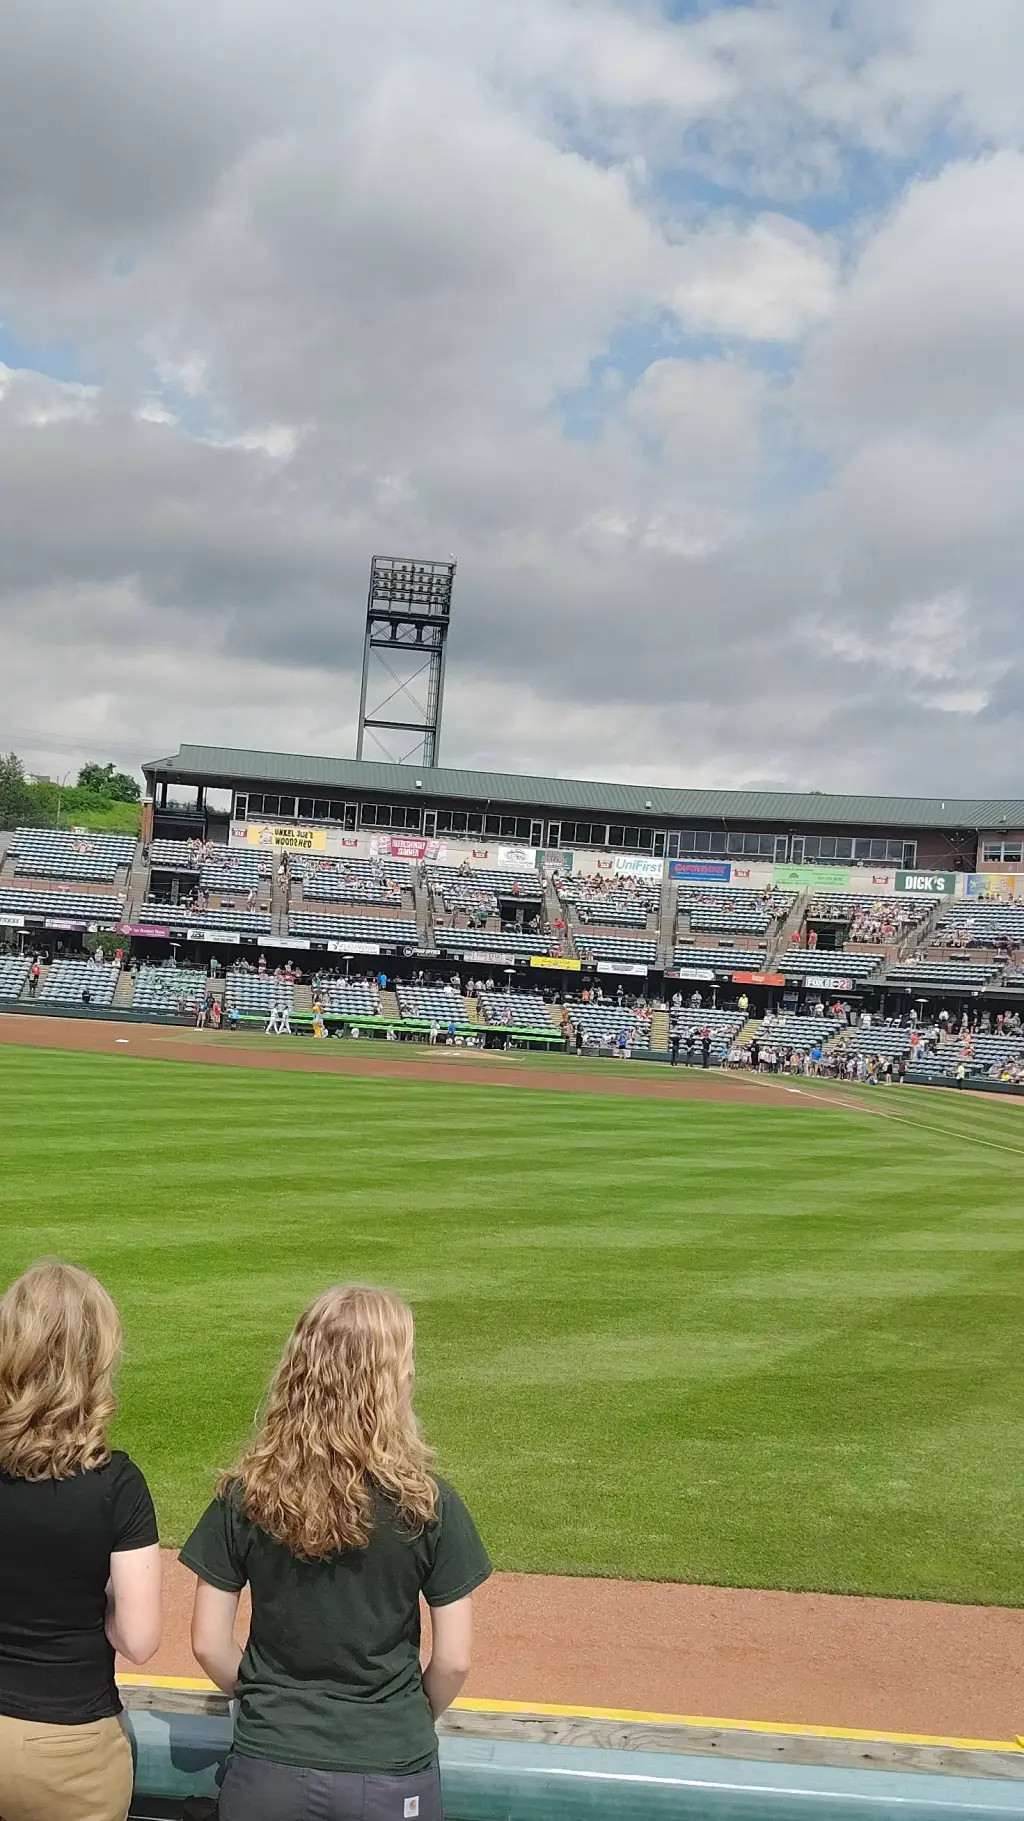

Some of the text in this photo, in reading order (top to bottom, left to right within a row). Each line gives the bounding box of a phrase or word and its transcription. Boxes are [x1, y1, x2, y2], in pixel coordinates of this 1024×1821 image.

[274, 828, 295, 837] UNKEL
[275, 837, 312, 848] WOODSHED
[615, 858, 662, 872] UniFirst
[905, 876, 945, 890] DICK'S
[806, 979, 823, 987] FOX
[823, 979, 831, 987] 8
